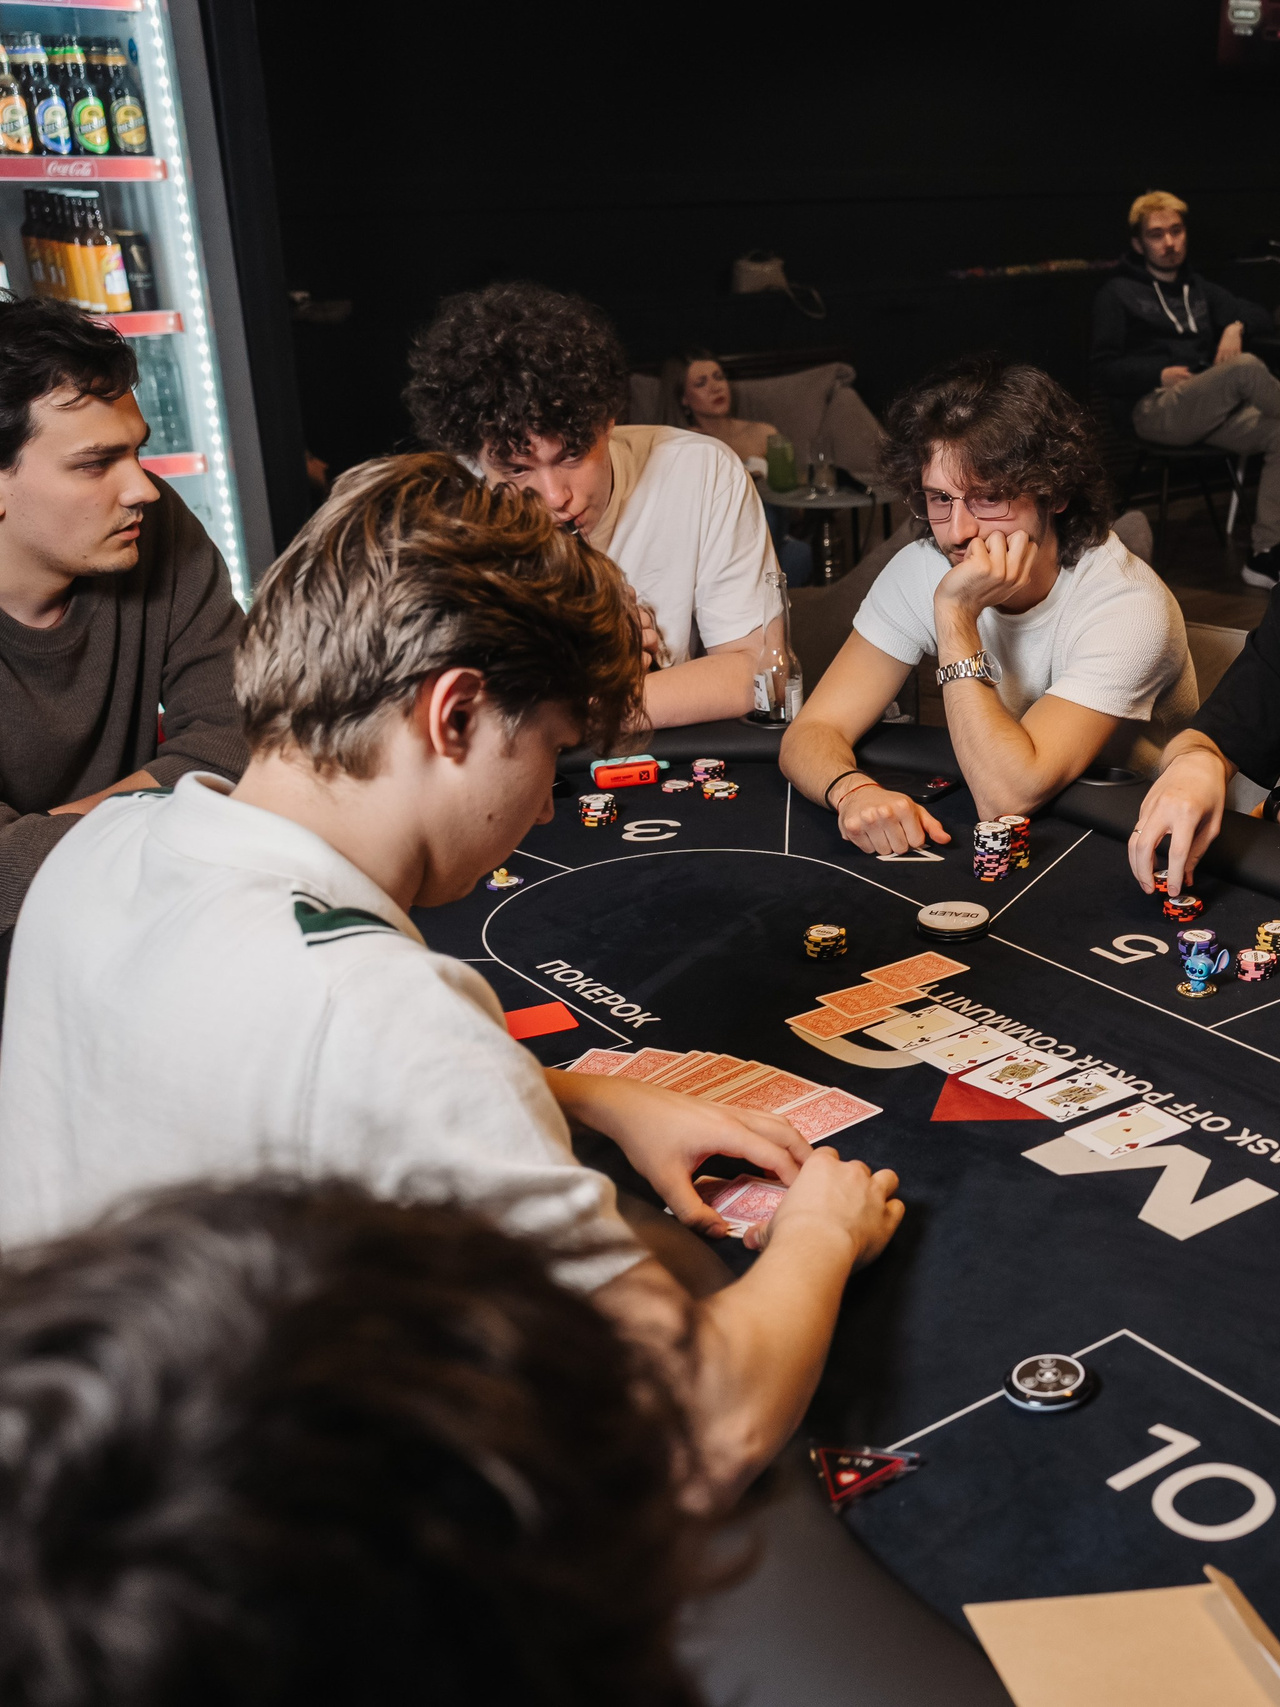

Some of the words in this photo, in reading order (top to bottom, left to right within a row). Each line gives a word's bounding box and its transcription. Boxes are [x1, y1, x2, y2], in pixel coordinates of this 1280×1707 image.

[621, 819, 682, 842] 3
[928, 910, 980, 919] DEALER
[1090, 933, 1170, 964] 5
[535, 959, 662, 1029] ПОКЕРОК
[1163, 1103, 1232, 1132] OFF
[1106, 1423, 1277, 1542] 10
